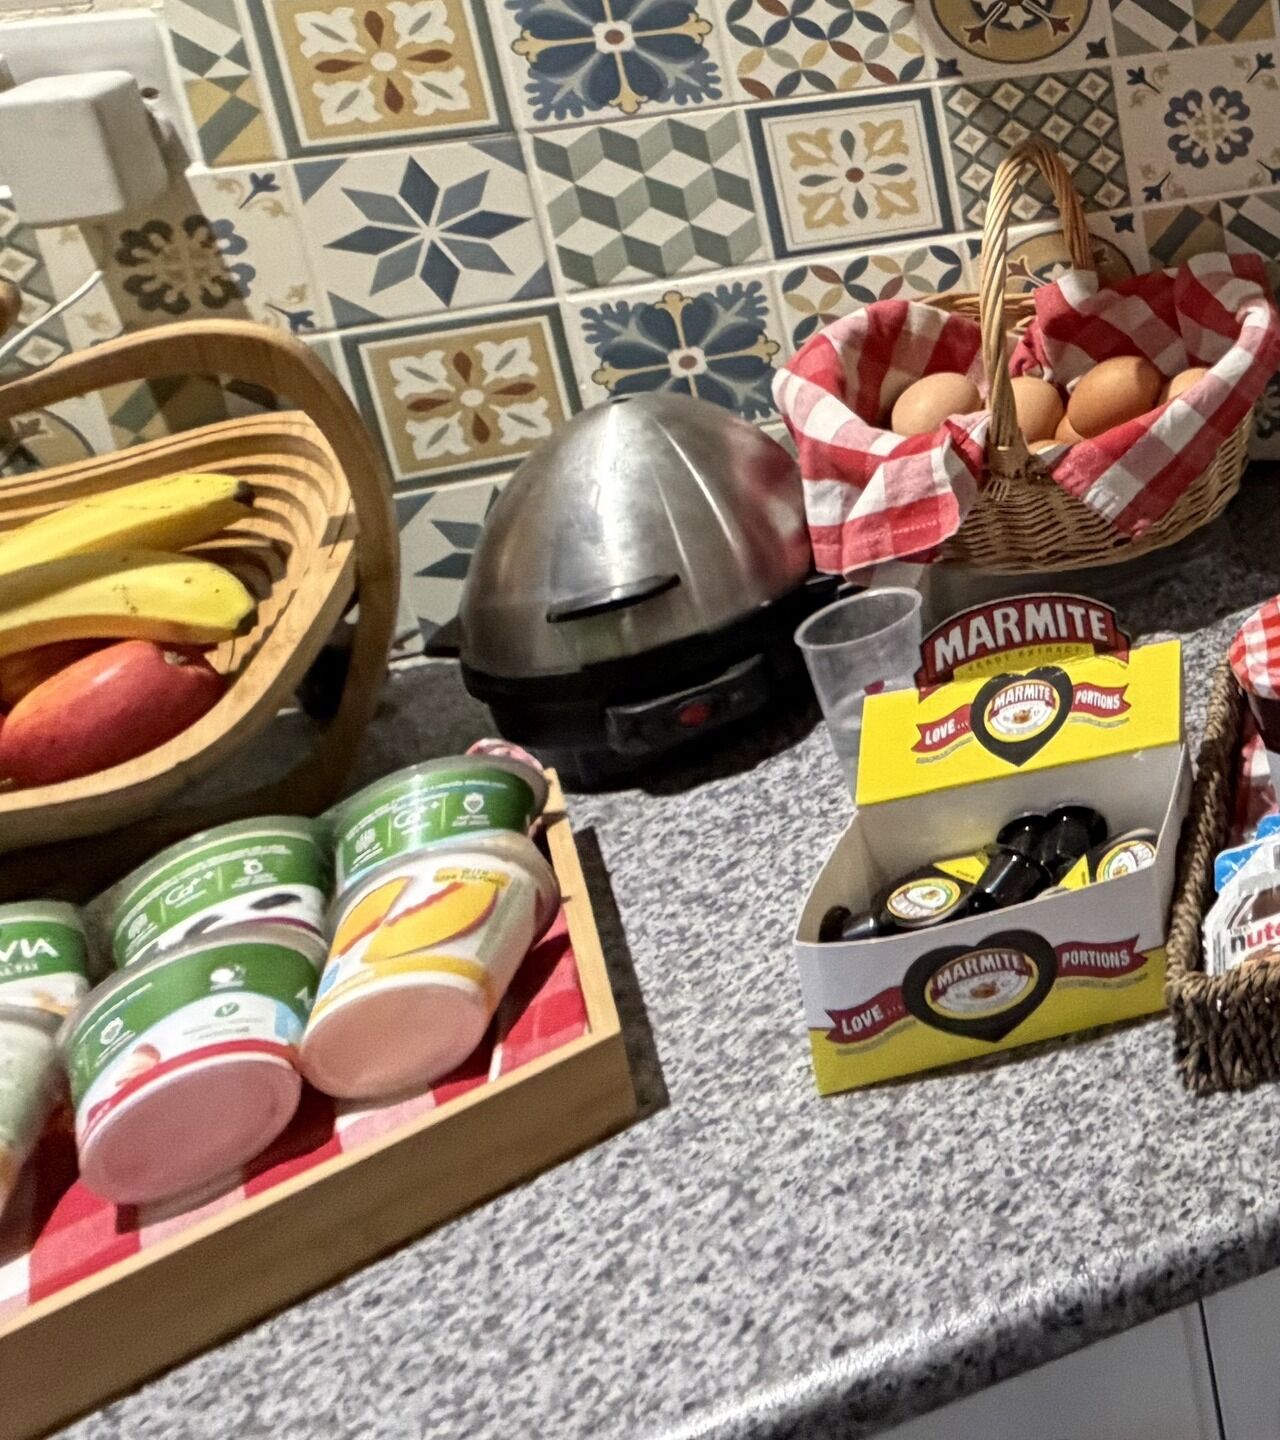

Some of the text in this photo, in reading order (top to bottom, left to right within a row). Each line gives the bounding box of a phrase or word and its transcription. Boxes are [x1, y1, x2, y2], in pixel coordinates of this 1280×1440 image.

[934, 603, 1109, 673] MARMITE
[993, 683, 1052, 711] MARMITE
[1075, 687, 1121, 710] PORTIONS
[935, 951, 1026, 991] MARMITE
[1061, 949, 1131, 970] PORTIONS
